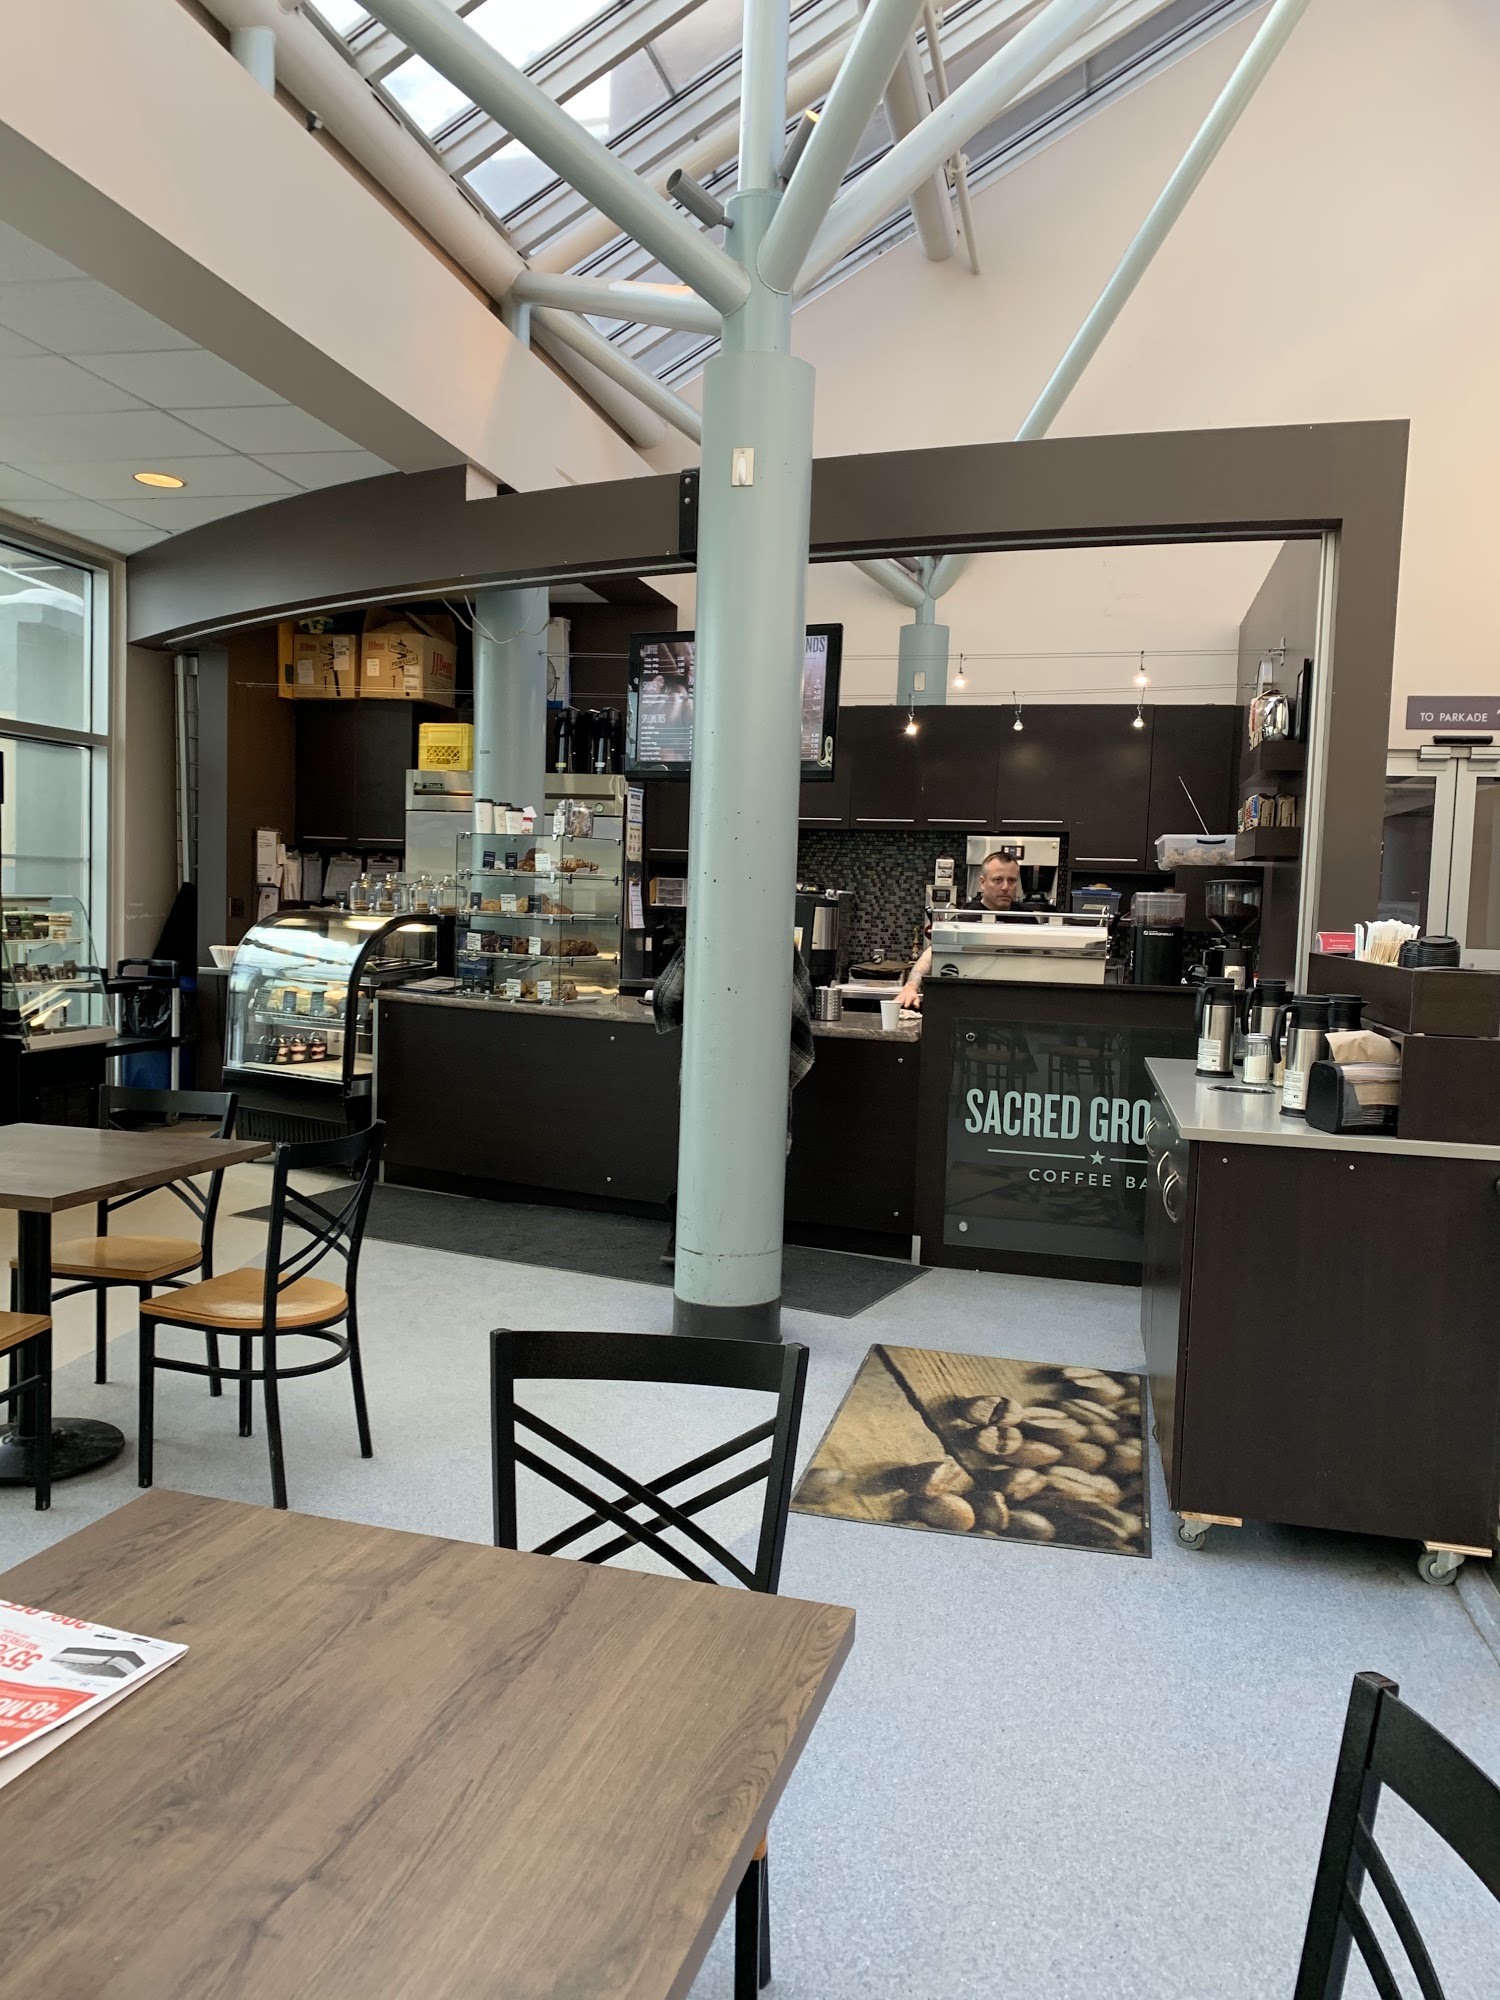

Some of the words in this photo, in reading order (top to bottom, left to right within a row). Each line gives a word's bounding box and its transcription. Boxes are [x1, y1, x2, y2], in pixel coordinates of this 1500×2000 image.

[1420, 712, 1434, 722] TO
[1439, 712, 1488, 722] PARKADE
[964, 1088, 1081, 1140] SACRED
[1028, 1168, 1112, 1187] COFFEE
[19, 1701, 60, 1720] 48
